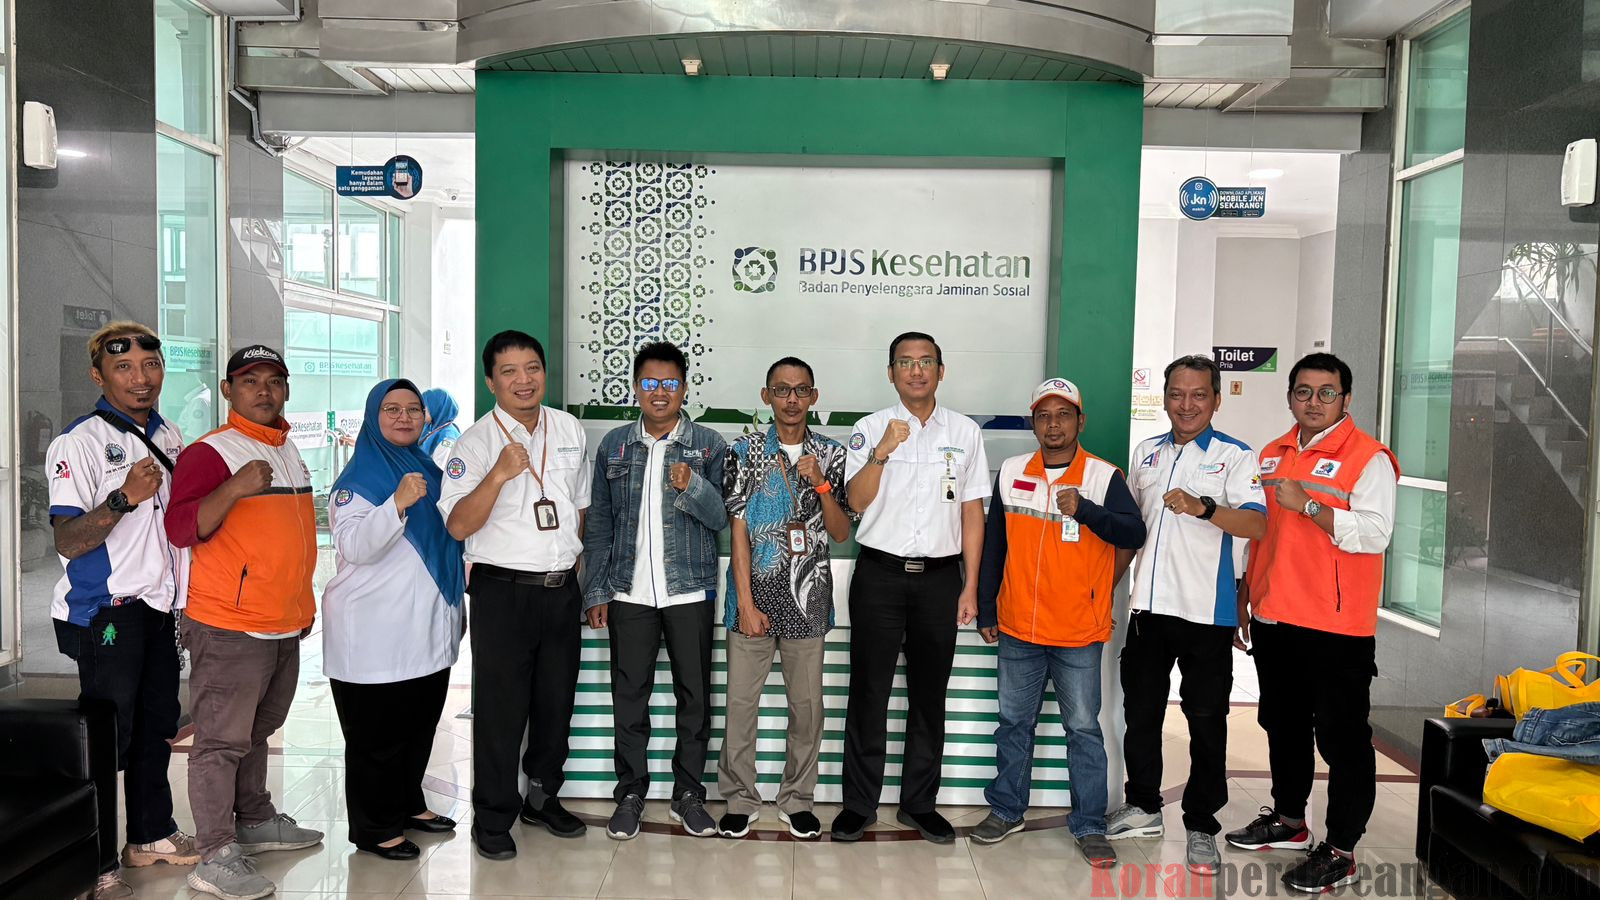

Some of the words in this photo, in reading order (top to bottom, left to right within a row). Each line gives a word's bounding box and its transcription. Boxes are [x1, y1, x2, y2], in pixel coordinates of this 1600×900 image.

[799, 247, 865, 276] BPJS
[872, 249, 1031, 279] Kesehatan
[799, 280, 838, 295] Badan
[841, 281, 933, 298] Penyelenggara
[936, 283, 988, 297] Jaminan
[992, 284, 1031, 298] Sosial
[1218, 348, 1255, 362] Toilet
[1219, 361, 1233, 369] Pria
